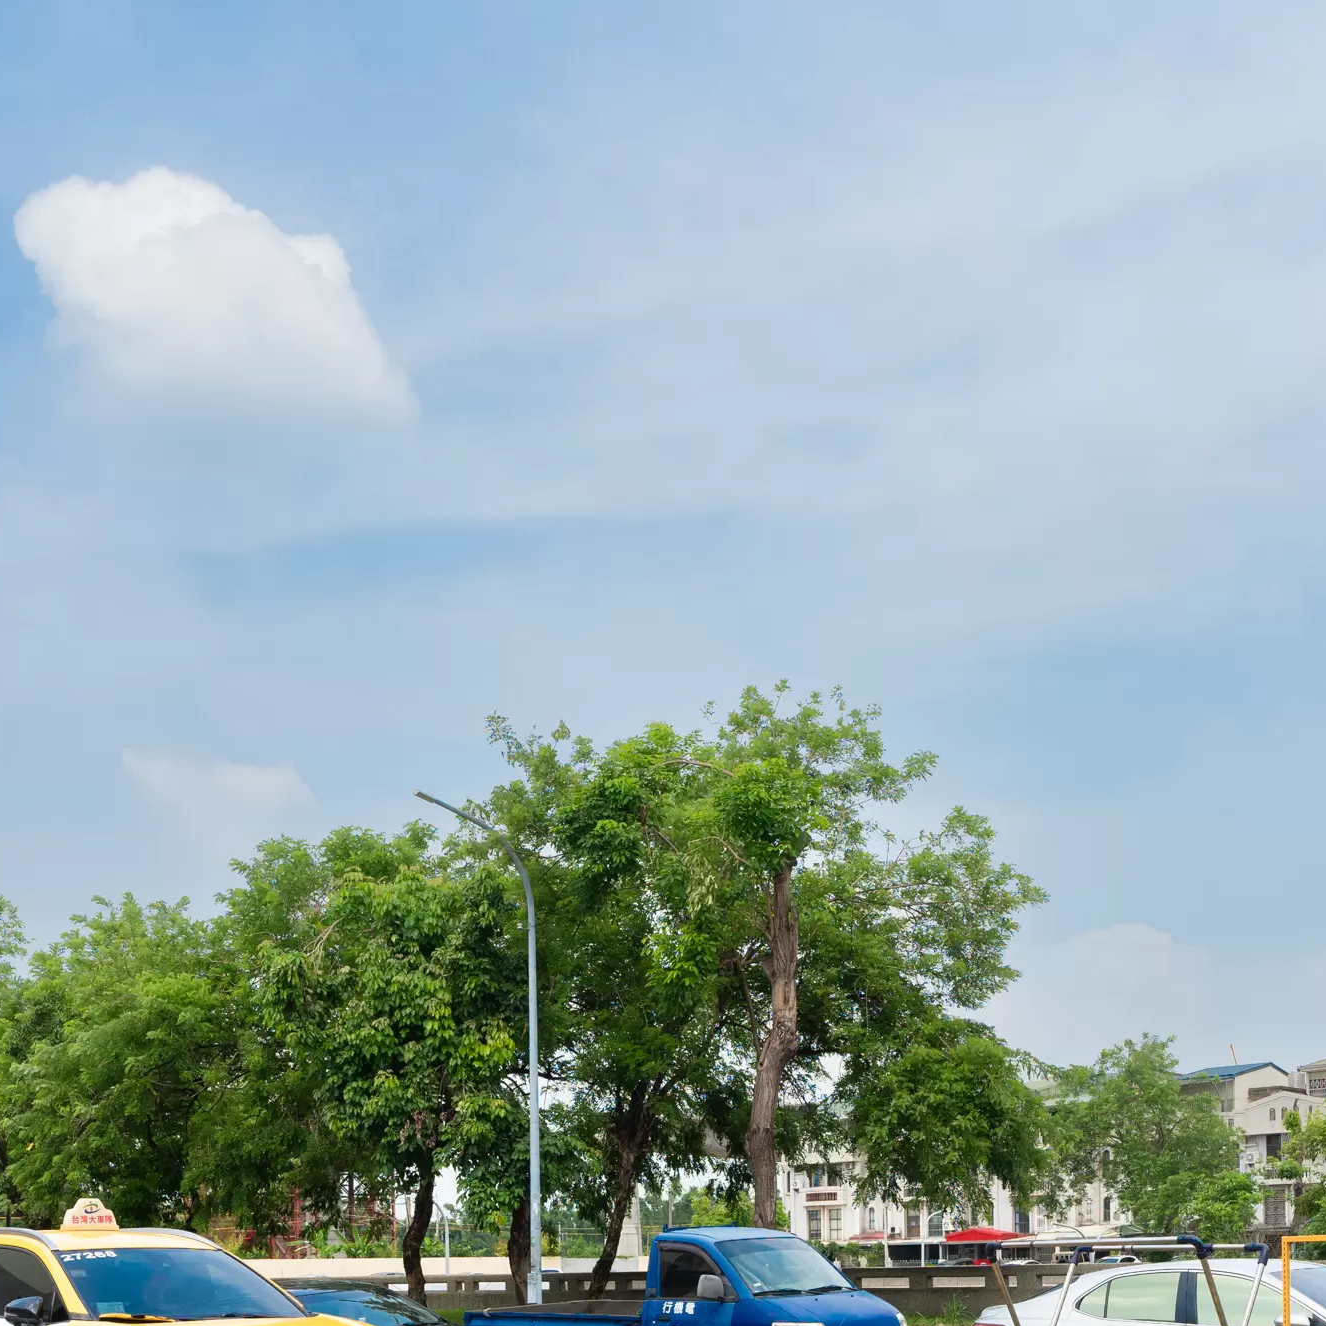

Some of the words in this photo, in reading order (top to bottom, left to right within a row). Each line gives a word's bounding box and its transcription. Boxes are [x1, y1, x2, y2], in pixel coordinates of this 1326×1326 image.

[71, 1215, 113, 1224] 台灣大車隊
